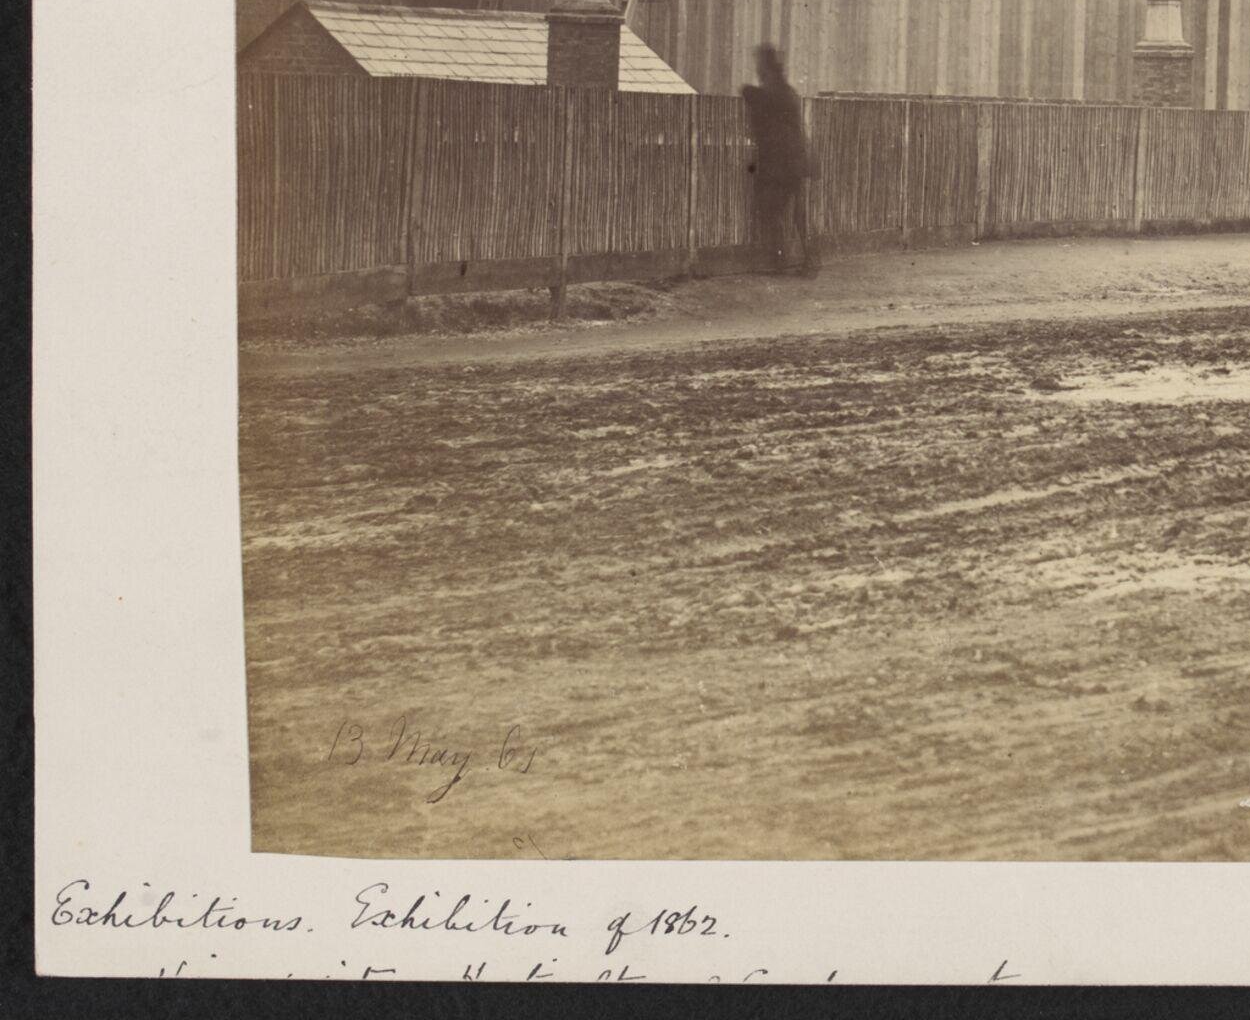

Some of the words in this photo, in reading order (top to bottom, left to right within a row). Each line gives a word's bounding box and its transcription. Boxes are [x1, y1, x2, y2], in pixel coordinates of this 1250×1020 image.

[327, 720, 364, 766] 13
[49, 879, 315, 935] Exhibitions.
[351, 881, 573, 937] Exhibition
[606, 912, 643, 958] of
